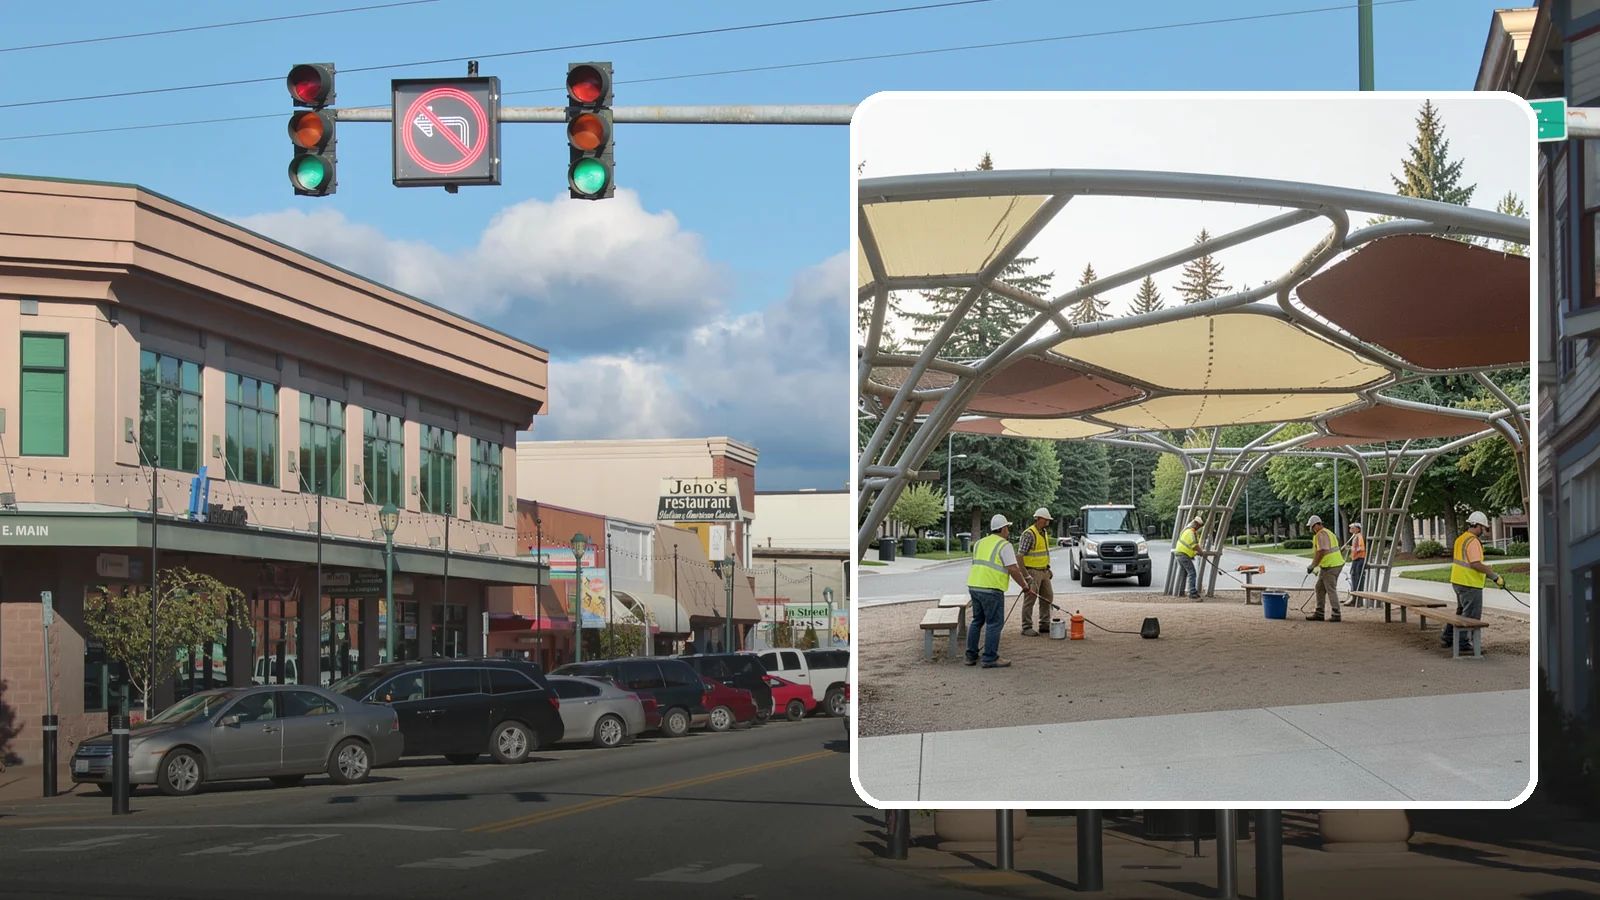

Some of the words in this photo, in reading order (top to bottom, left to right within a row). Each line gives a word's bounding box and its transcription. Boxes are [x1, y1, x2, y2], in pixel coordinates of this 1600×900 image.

[669, 480, 728, 494] Jeno's
[665, 496, 731, 509] restaurant
[658, 510, 681, 519] Italian
[685, 510, 714, 519] American
[714, 509, 738, 520] Cuisine
[2, 525, 13, 536] E.
[15, 525, 49, 536] MAIN
[785, 607, 795, 616] in
[797, 607, 828, 616] Street
[790, 619, 823, 627] lass
